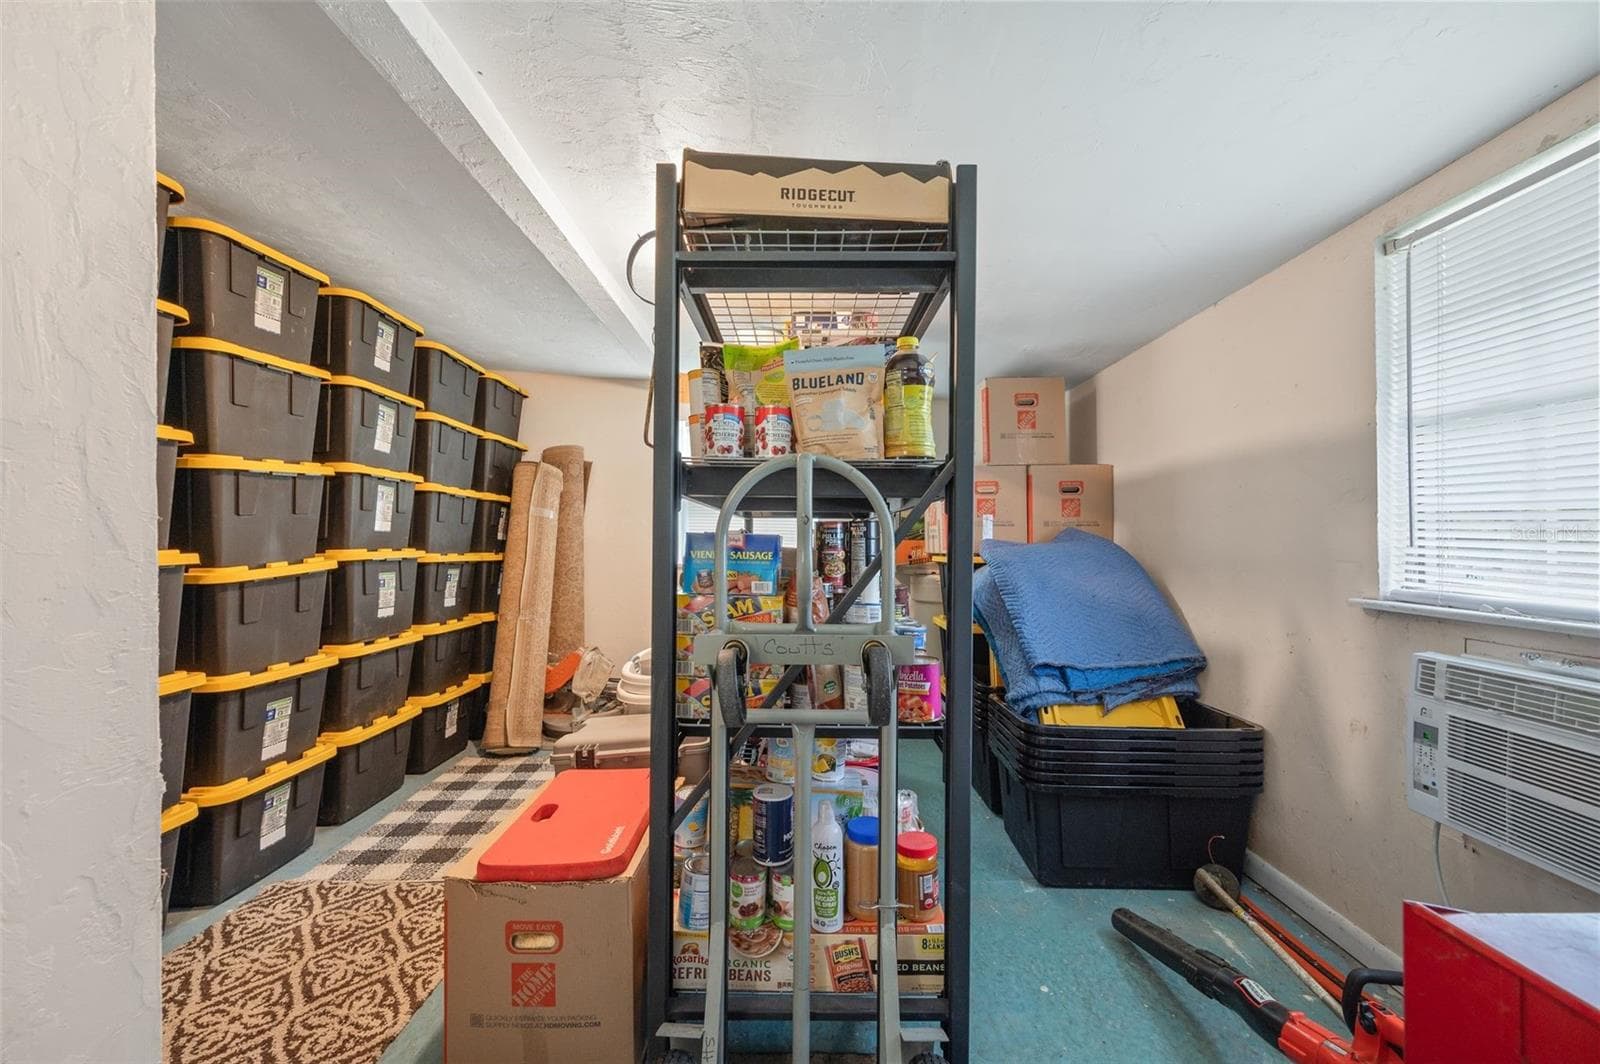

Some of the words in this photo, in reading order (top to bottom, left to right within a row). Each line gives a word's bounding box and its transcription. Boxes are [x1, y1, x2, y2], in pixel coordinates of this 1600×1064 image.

[780, 187, 856, 202] RIDGECUT
[792, 372, 865, 390] BLUELAND
[730, 551, 773, 560] SAUSAGE
[701, 598, 755, 629] SAM
[513, 923, 532, 931] MOVE
[534, 923, 556, 931] EASY
[922, 938, 928, 950] 8
[834, 946, 860, 960] BUSH'S
[515, 967, 534, 985] THE
[728, 969, 772, 982] BEANS
[512, 962, 554, 1006] HOME
[529, 978, 556, 1006] DEPOT
